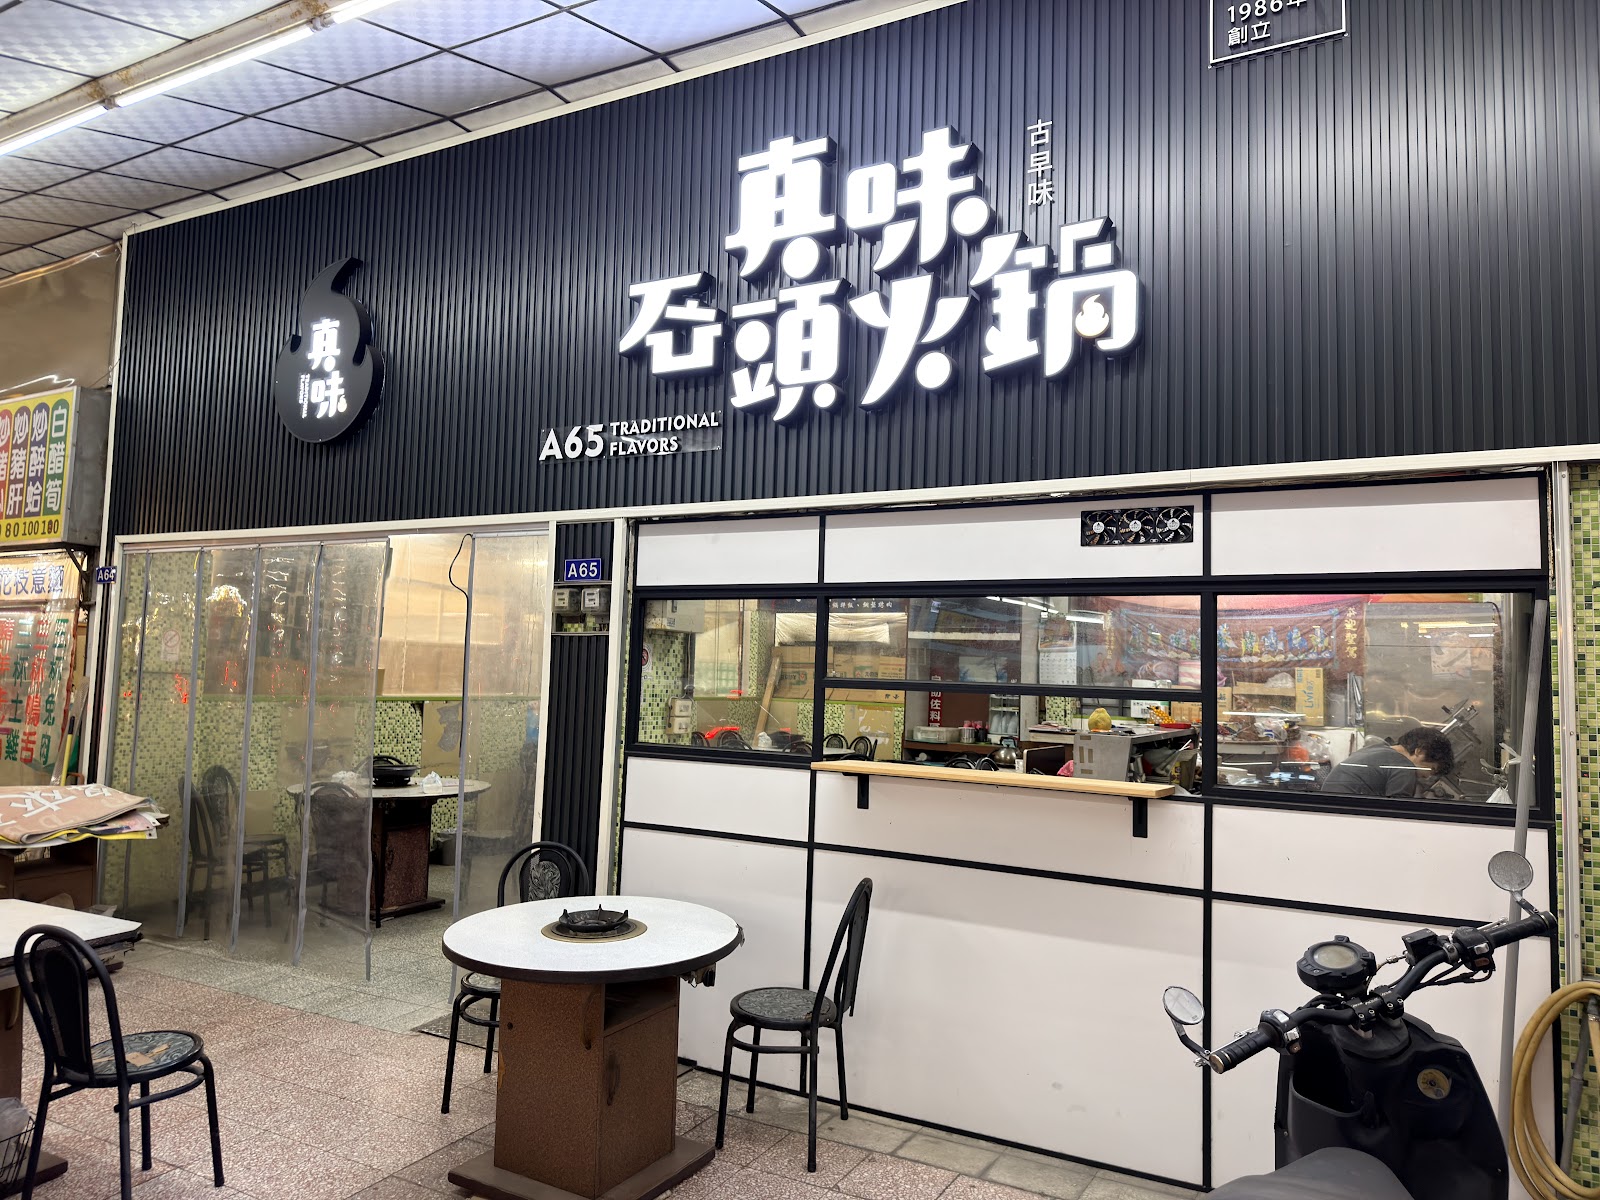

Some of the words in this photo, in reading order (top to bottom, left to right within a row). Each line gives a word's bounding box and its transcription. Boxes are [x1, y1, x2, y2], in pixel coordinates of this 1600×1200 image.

[1228, 21, 1271, 46] 創立
[1027, 119, 1053, 206] 古早味
[725, 125, 990, 280] 真味
[619, 216, 1139, 421] 石頭火鍋
[307, 318, 347, 419] 真味
[539, 424, 604, 461] A65
[610, 412, 719, 436] TRADITIONAL
[610, 436, 679, 456] FLAVORS
[6, 412, 29, 516] 炒豬肝
[25, 408, 48, 513] 炒醉蛤
[46, 405, 67, 512] 白醋筍
[5, 523, 19, 538] 80
[22, 520, 39, 536] 100
[97, 568, 115, 581] A64
[567, 562, 598, 578] A65
